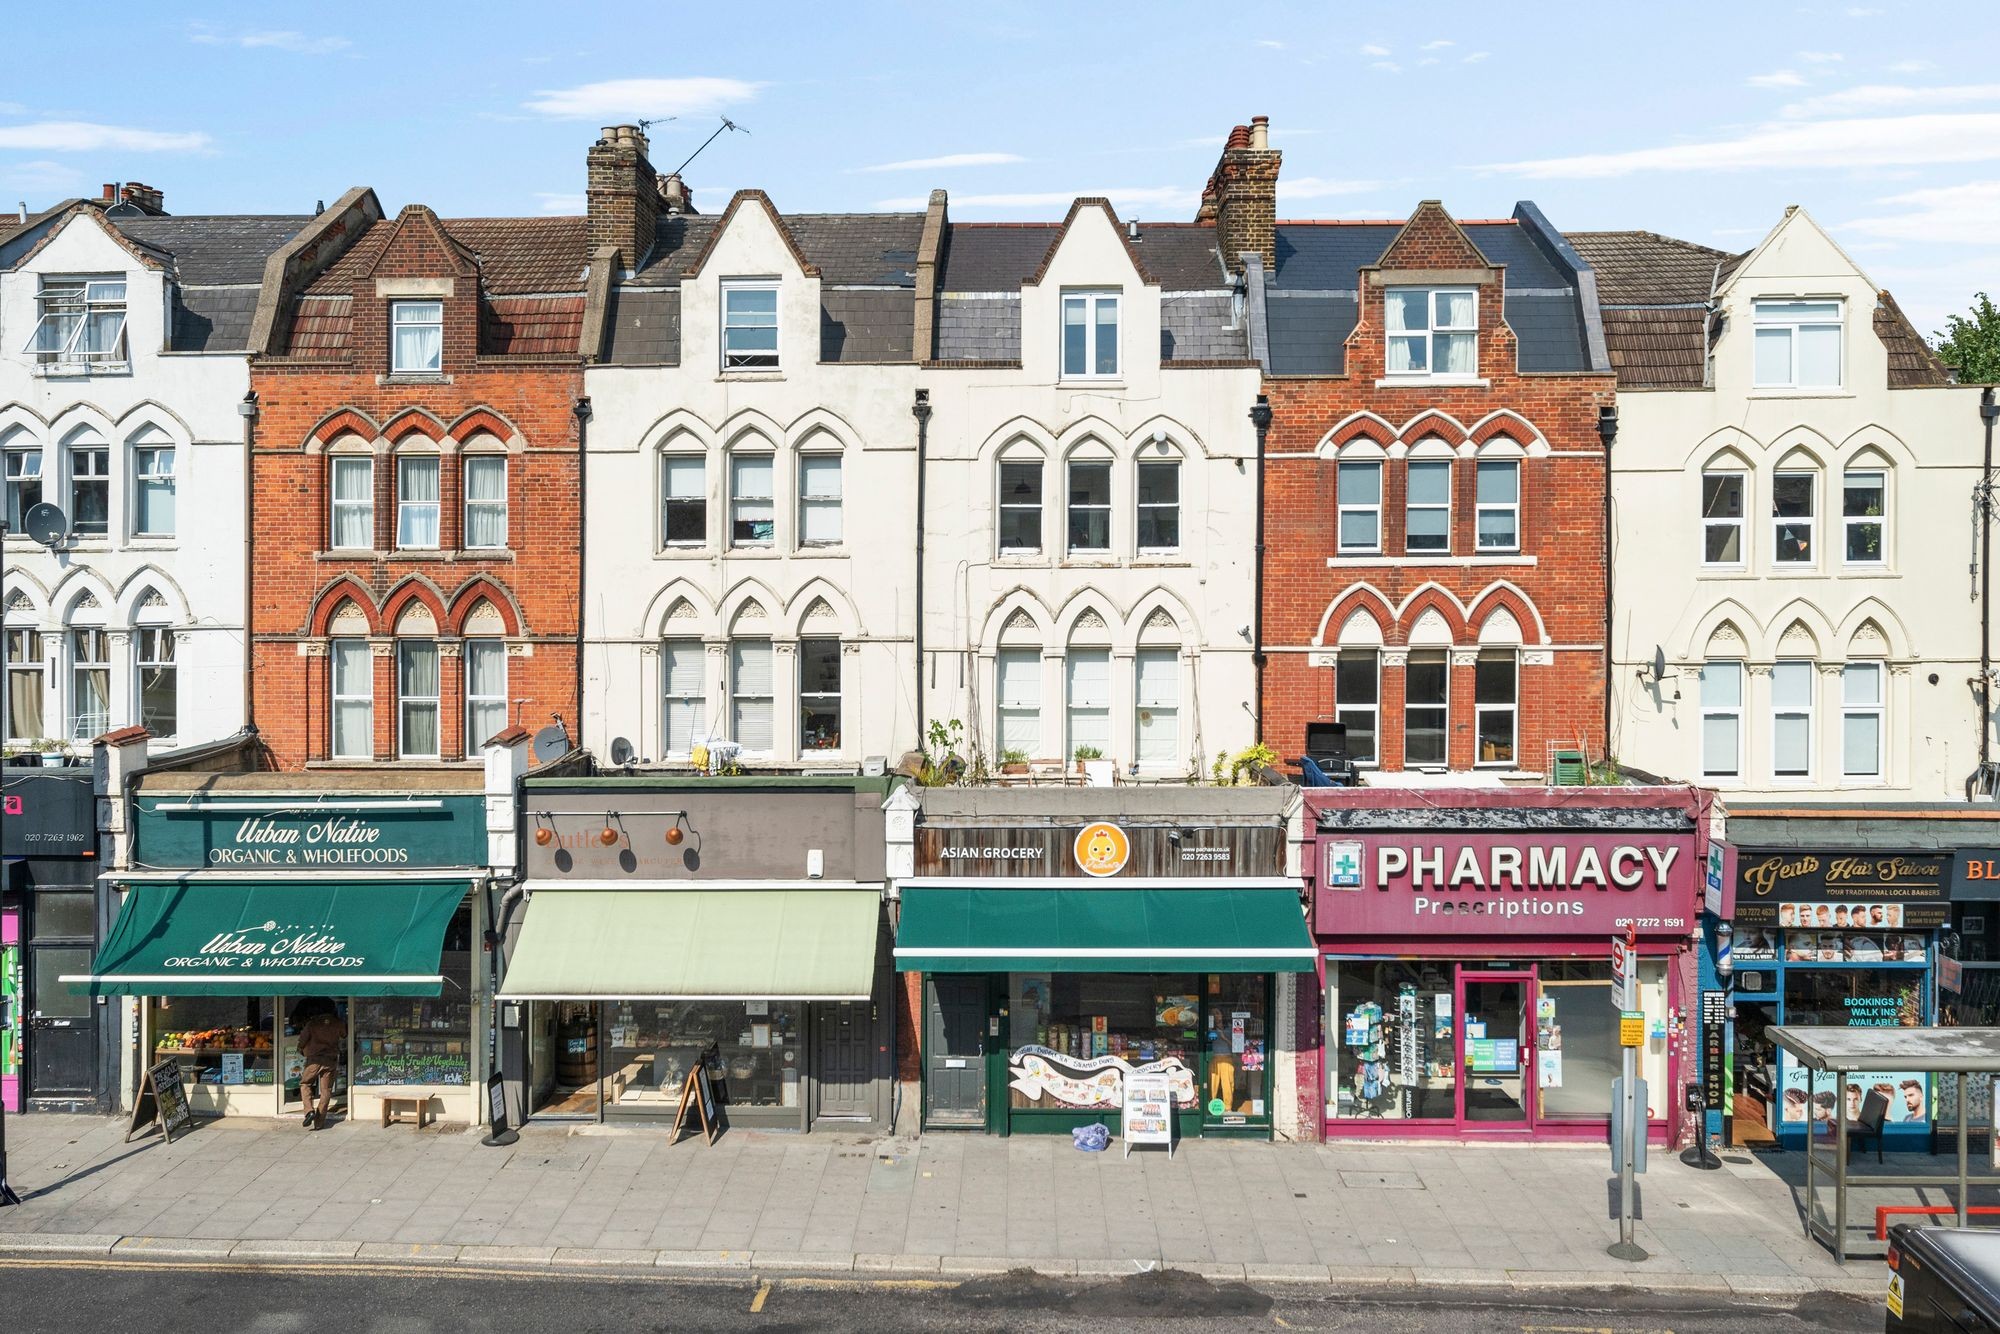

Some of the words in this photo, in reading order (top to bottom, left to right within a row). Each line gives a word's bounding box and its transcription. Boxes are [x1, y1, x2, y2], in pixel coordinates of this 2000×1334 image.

[236, 818, 300, 843] Urban
[306, 816, 380, 843] Native
[25, 833, 40, 842] 020
[43, 833, 64, 842] 7263
[66, 833, 85, 842] 1962
[209, 849, 280, 864] ORGANIC
[285, 849, 297, 864] &
[303, 849, 408, 863] WHOLEFOODS
[940, 847, 979, 859] ASIAN
[983, 847, 1043, 859] GROCERY
[1377, 846, 1679, 888] PHARMACY
[1744, 856, 1820, 896] Gents
[1825, 857, 1873, 882] Hair
[1876, 857, 1941, 882] Saloon
[1415, 898, 1584, 919] Prescriptions
[1637, 918, 1660, 927] 7272
[1663, 918, 1684, 927] 1591
[200, 933, 266, 955] Urban
[271, 932, 346, 955] Native
[164, 957, 239, 967] ORGANIC
[241, 957, 253, 967] &
[260, 957, 365, 967] WHOLEFOODS
[1844, 997, 1894, 1006] BOOKINGS
[1896, 997, 1903, 1006] &
[1851, 1008, 1878, 1016] WALK
[1881, 1008, 1896, 1016] INS
[1848, 1018, 1900, 1026] AVAILABLE
[362, 1055, 384, 1069] Daily
[1790, 1070, 1809, 1083] Gen
[1845, 1072, 1866, 1080] aloon
